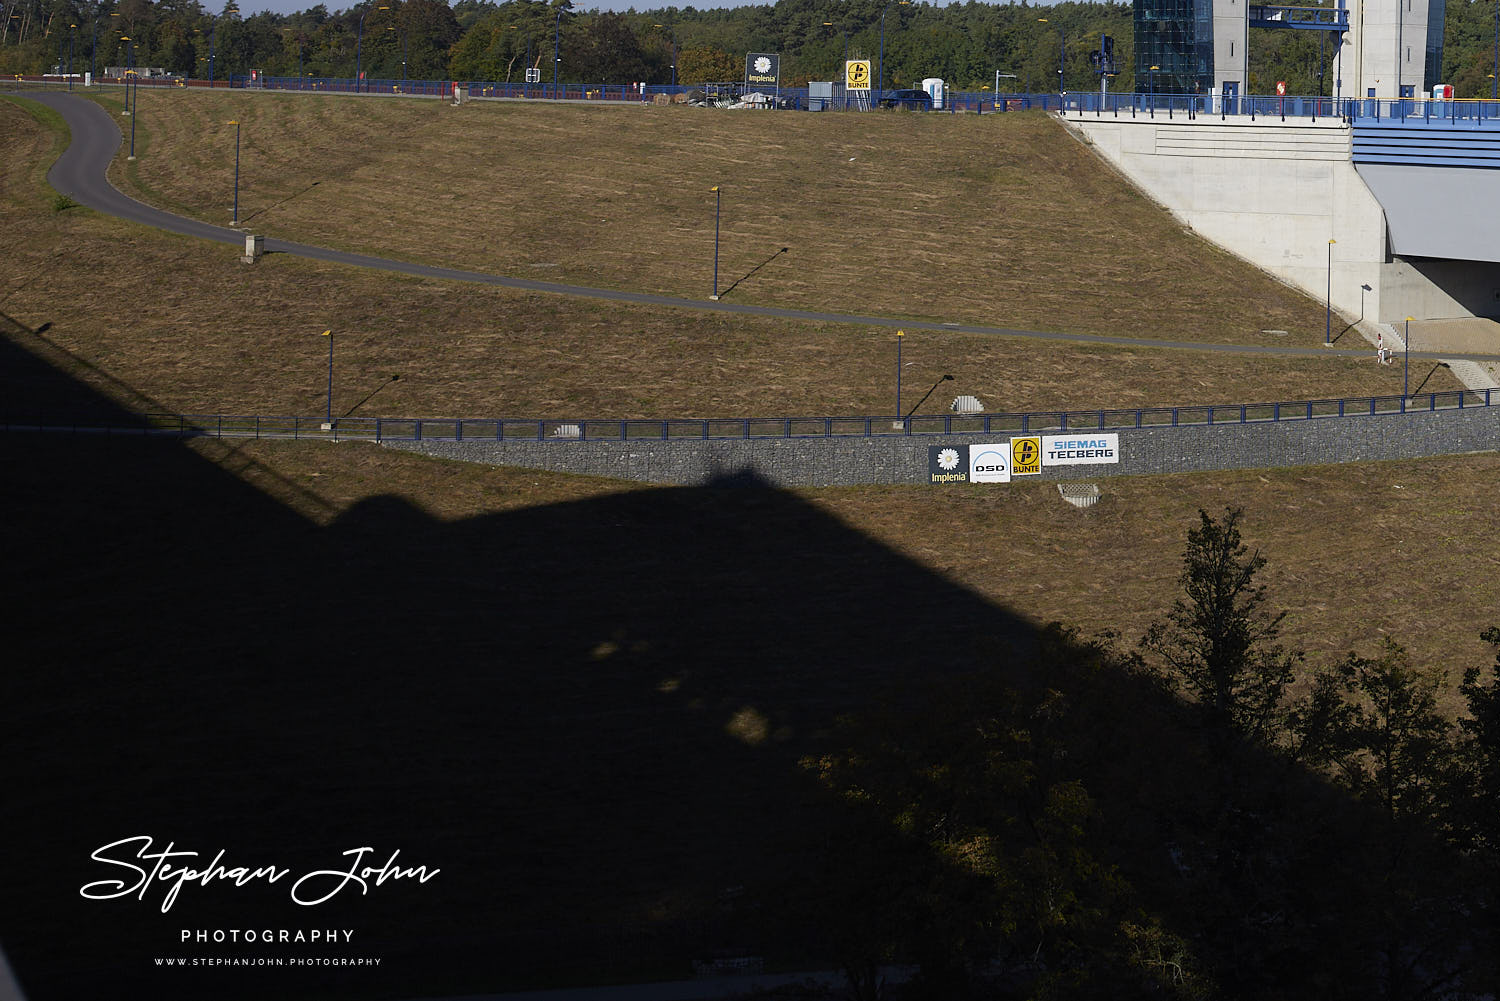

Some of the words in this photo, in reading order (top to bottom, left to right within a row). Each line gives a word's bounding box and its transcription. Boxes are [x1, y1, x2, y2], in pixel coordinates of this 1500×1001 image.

[749, 74, 776, 83] Implenia
[1054, 440, 1107, 449] SIEMAG
[1048, 449, 1113, 459] TECBERG
[1013, 465, 1039, 473] BUNTE
[931, 472, 966, 483] Implenia
